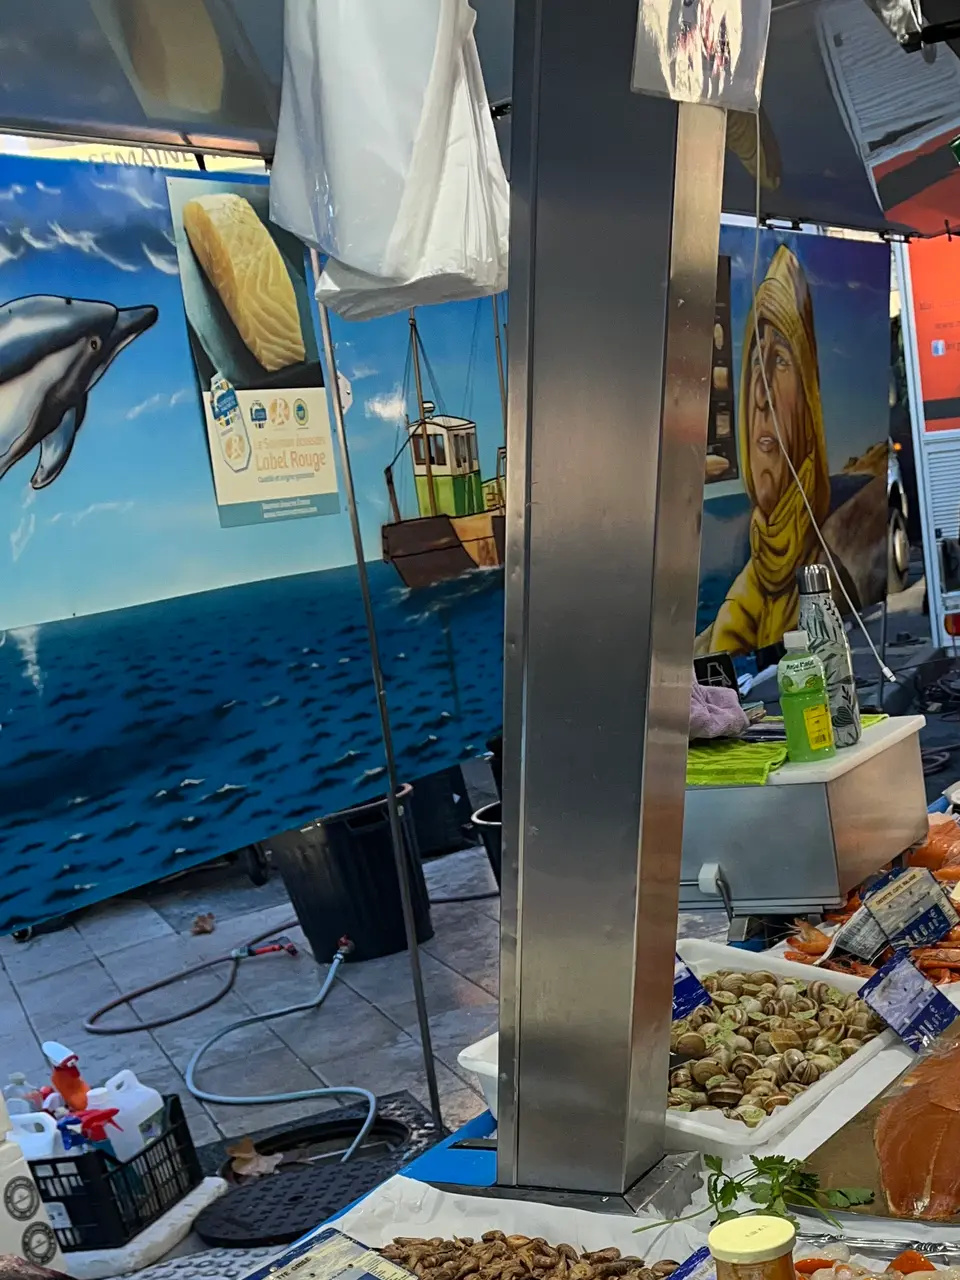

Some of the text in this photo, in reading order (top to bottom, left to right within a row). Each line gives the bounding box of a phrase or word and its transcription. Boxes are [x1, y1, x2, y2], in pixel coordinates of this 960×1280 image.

[255, 451, 326, 472] Label Rouge
[291, 1257, 312, 1271] GRISE
